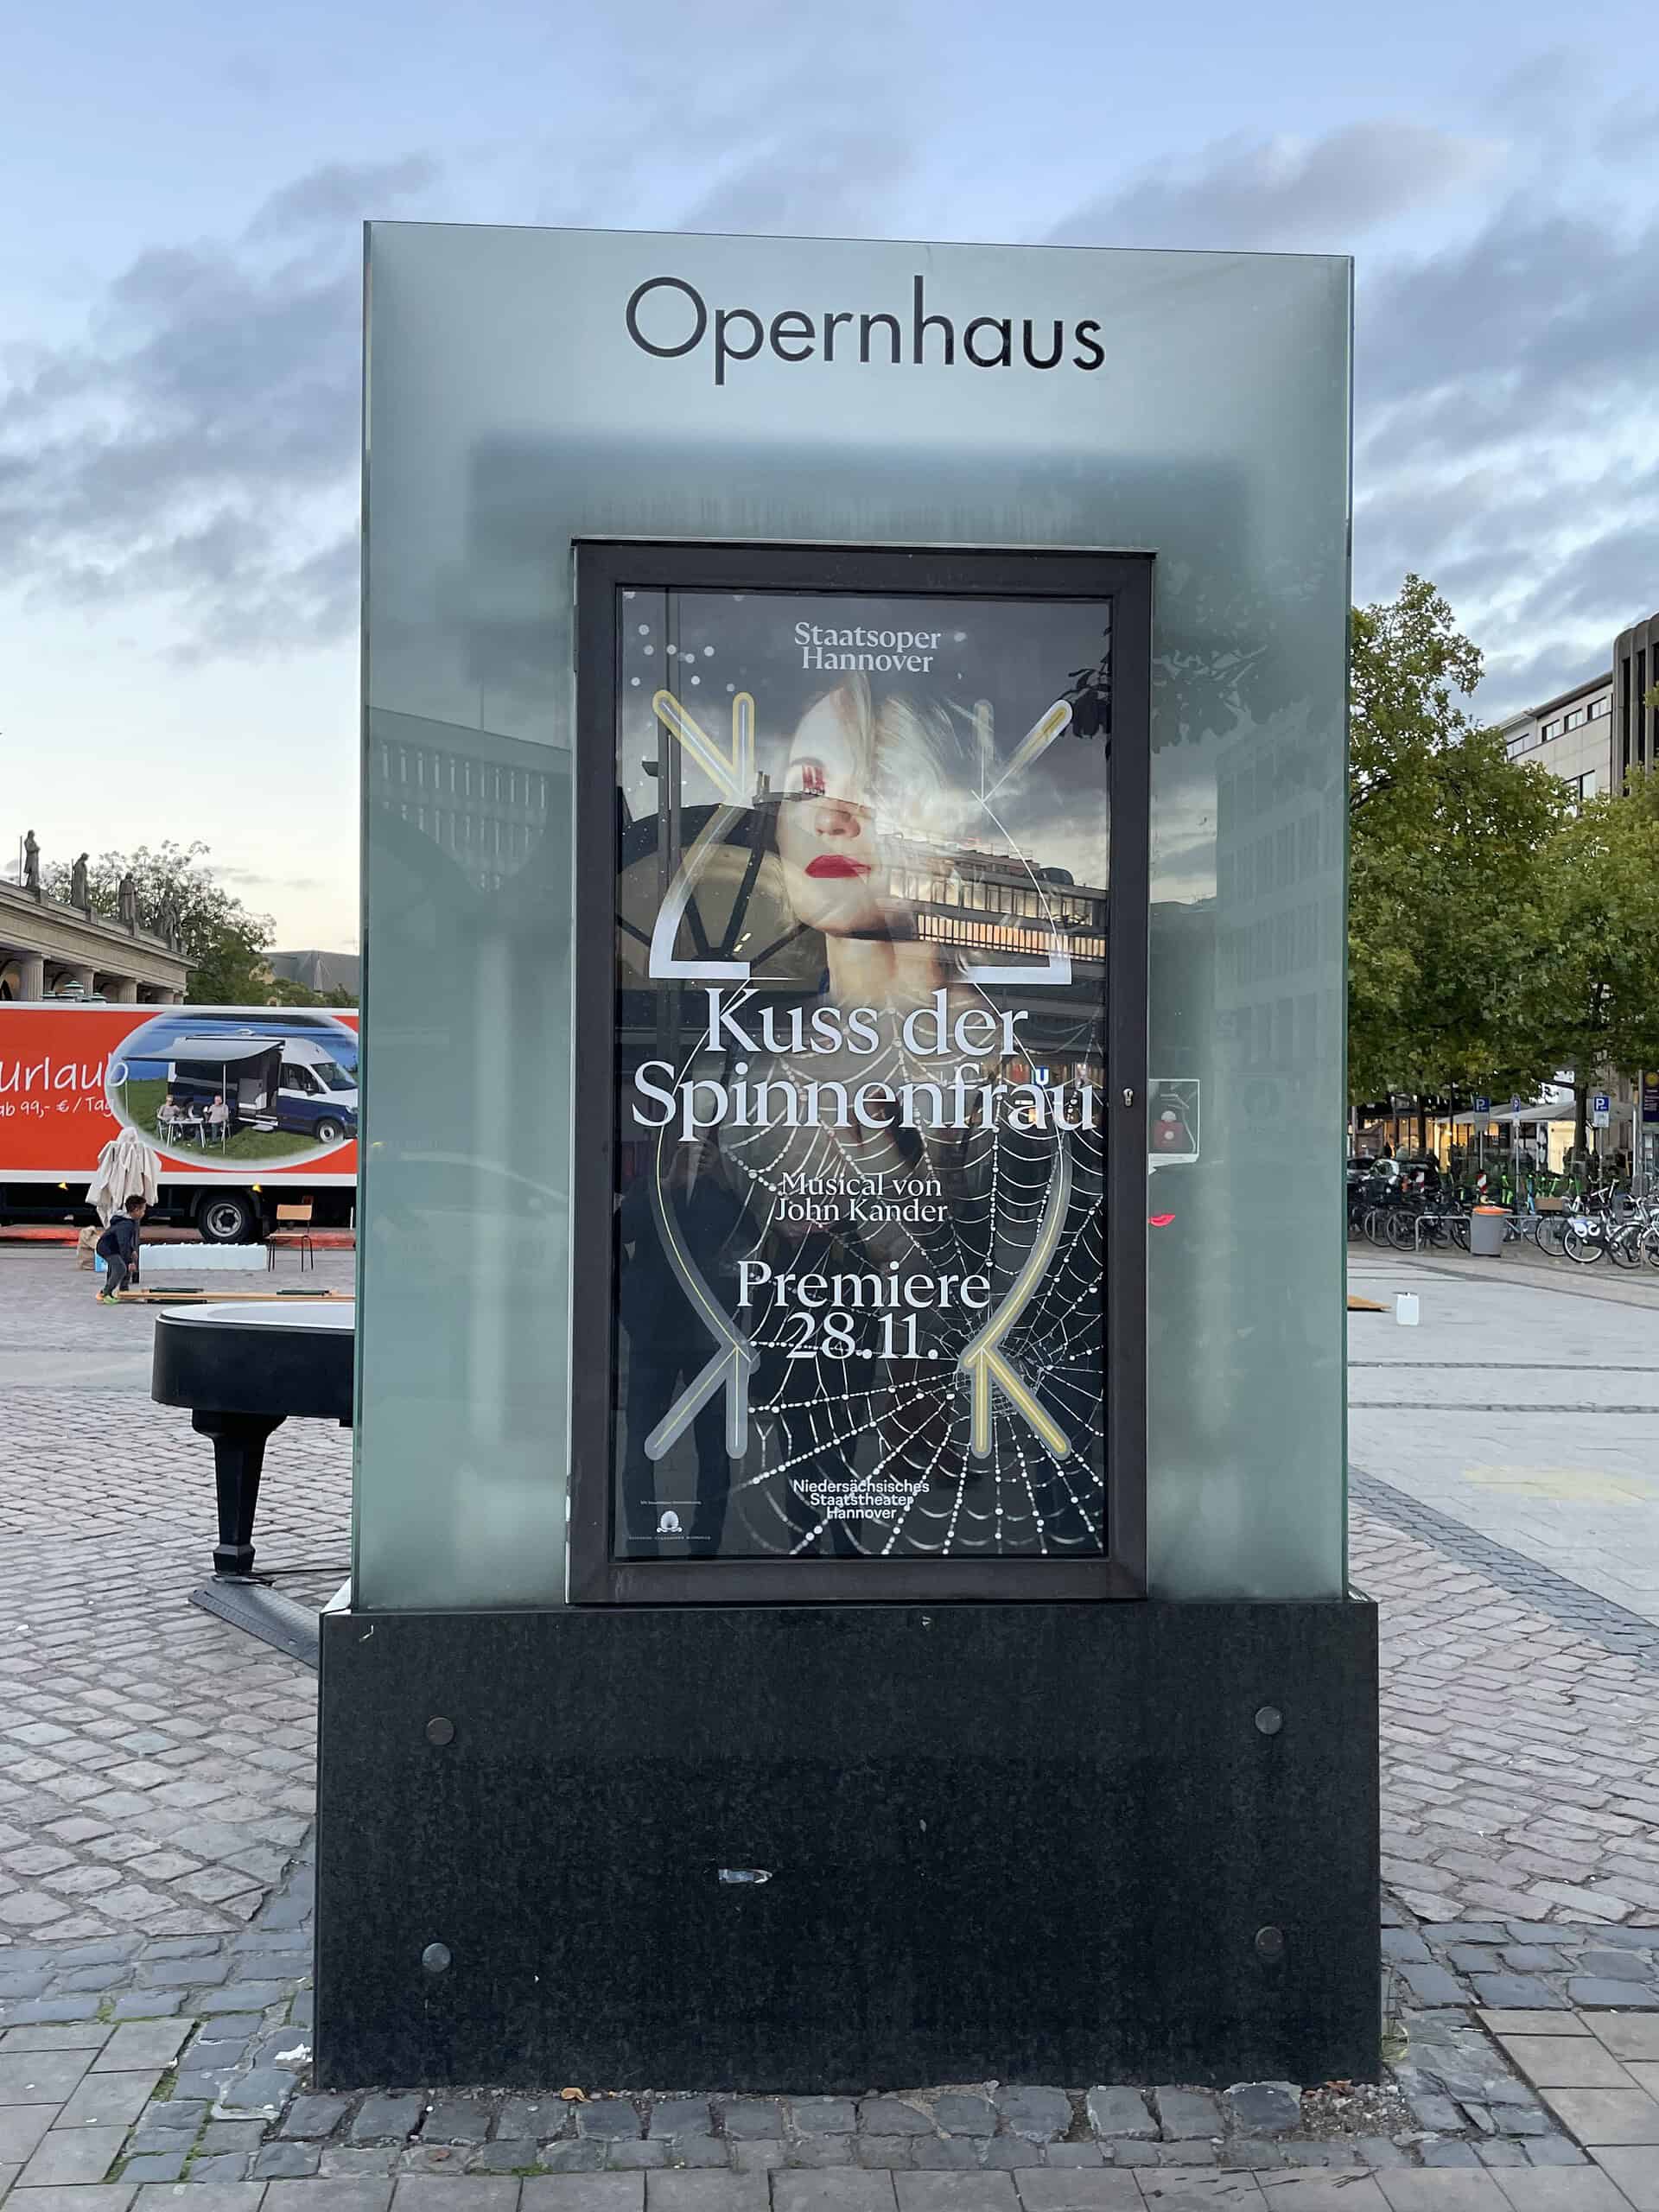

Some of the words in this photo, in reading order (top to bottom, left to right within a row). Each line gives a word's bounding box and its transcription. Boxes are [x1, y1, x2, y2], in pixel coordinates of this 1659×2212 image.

[626, 275, 1106, 385] Opernhaus
[794, 621, 942, 653] Staatsoper
[802, 646, 934, 672] Hannover
[703, 988, 880, 1055] Kuss
[902, 988, 1028, 1057] der
[0, 1052, 129, 1092] Urlaub
[0, 1102, 16, 1117] ab
[85, 1096, 114, 1117] Tag
[632, 1060, 1097, 1142] Spinnenfrau
[782, 1172, 884, 1196] Musical
[892, 1179, 942, 1197] von
[775, 1198, 840, 1221] John
[849, 1198, 948, 1222] Kander
[736, 1260, 990, 1308] Premiere
[786, 1312, 938, 1359] 28.11.
[793, 1478, 930, 1493] Niedersächsisches
[810, 1493, 914, 1506] Staatstheater
[827, 1506, 897, 1519] Hannover
